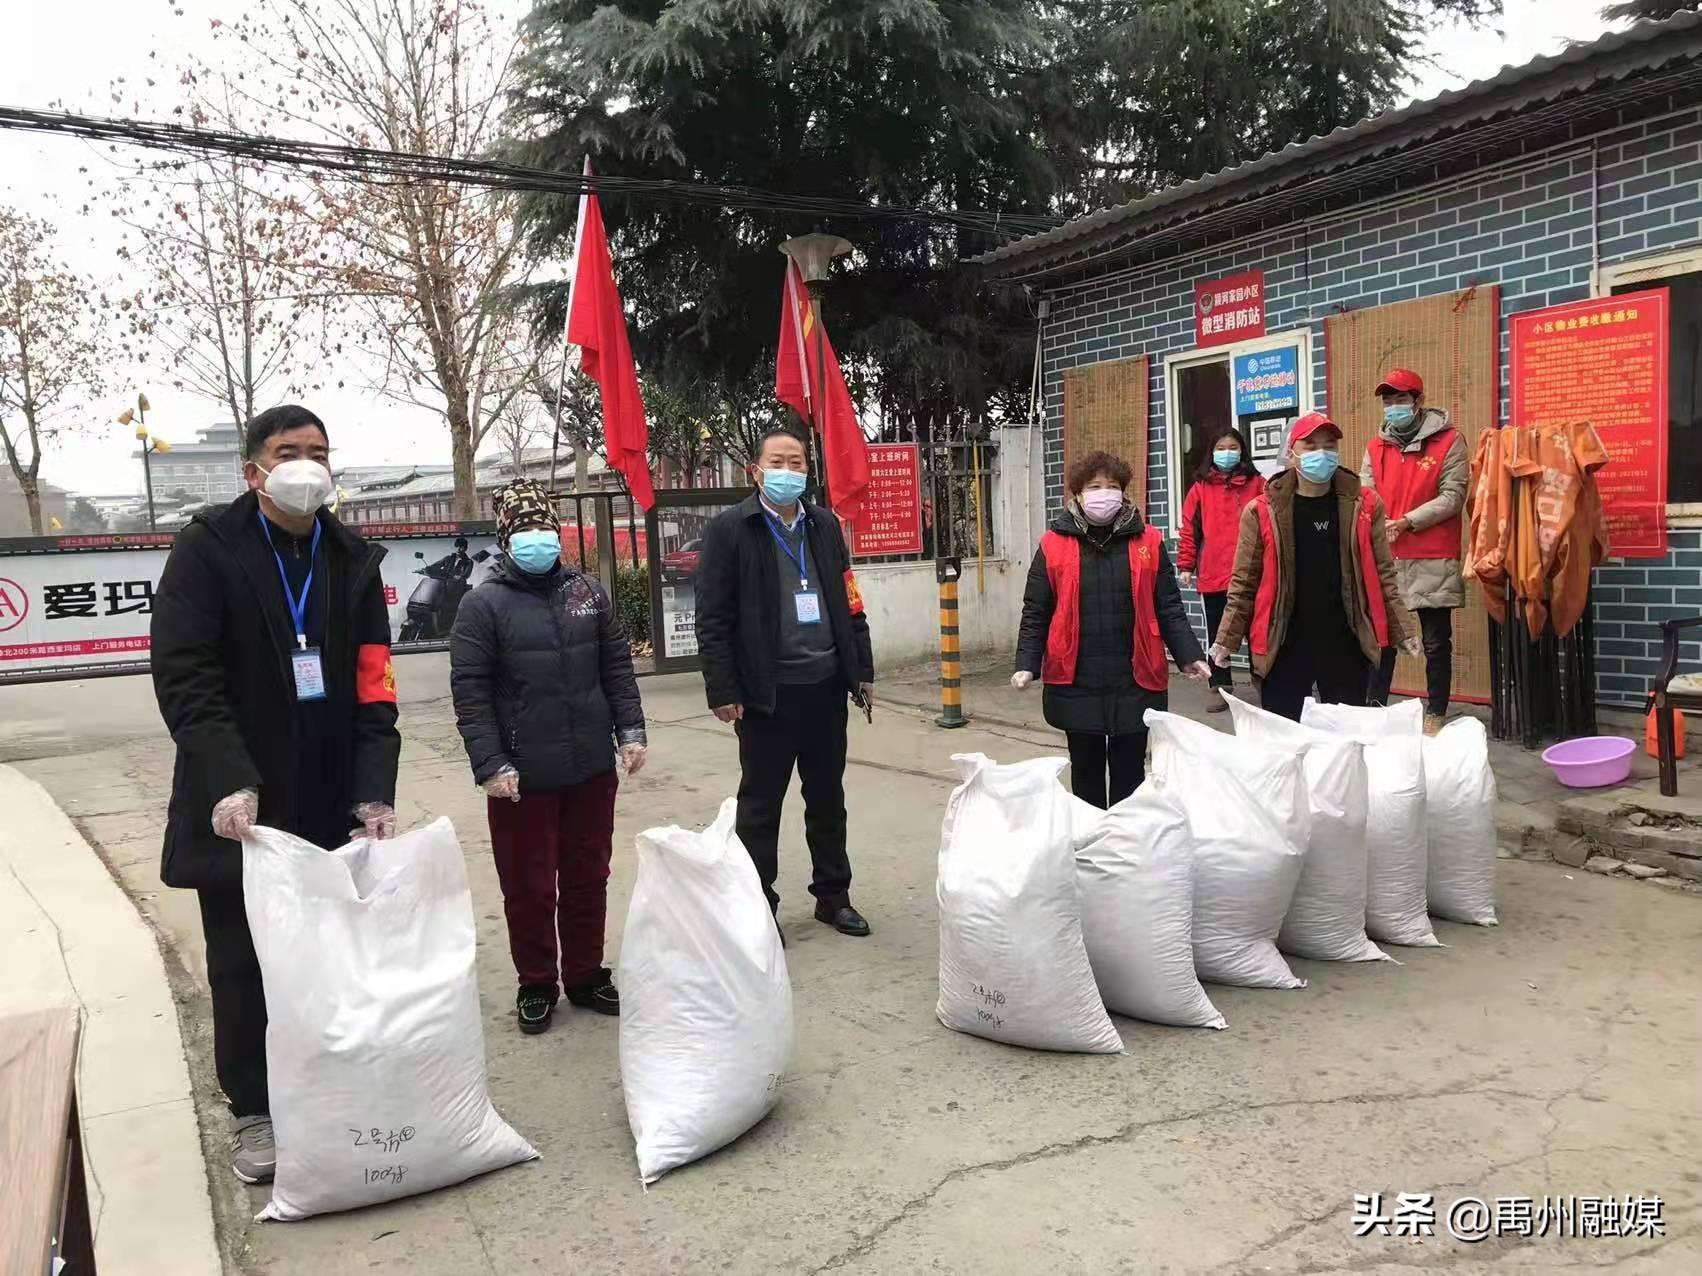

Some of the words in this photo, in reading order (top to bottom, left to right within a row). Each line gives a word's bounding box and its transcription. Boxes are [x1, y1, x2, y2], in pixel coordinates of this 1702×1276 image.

[1202, 306, 1260, 336] 微型消防站
[1533, 309, 1638, 335] 小区物业费收缴通知
[43, 580, 157, 620] 爱玛
